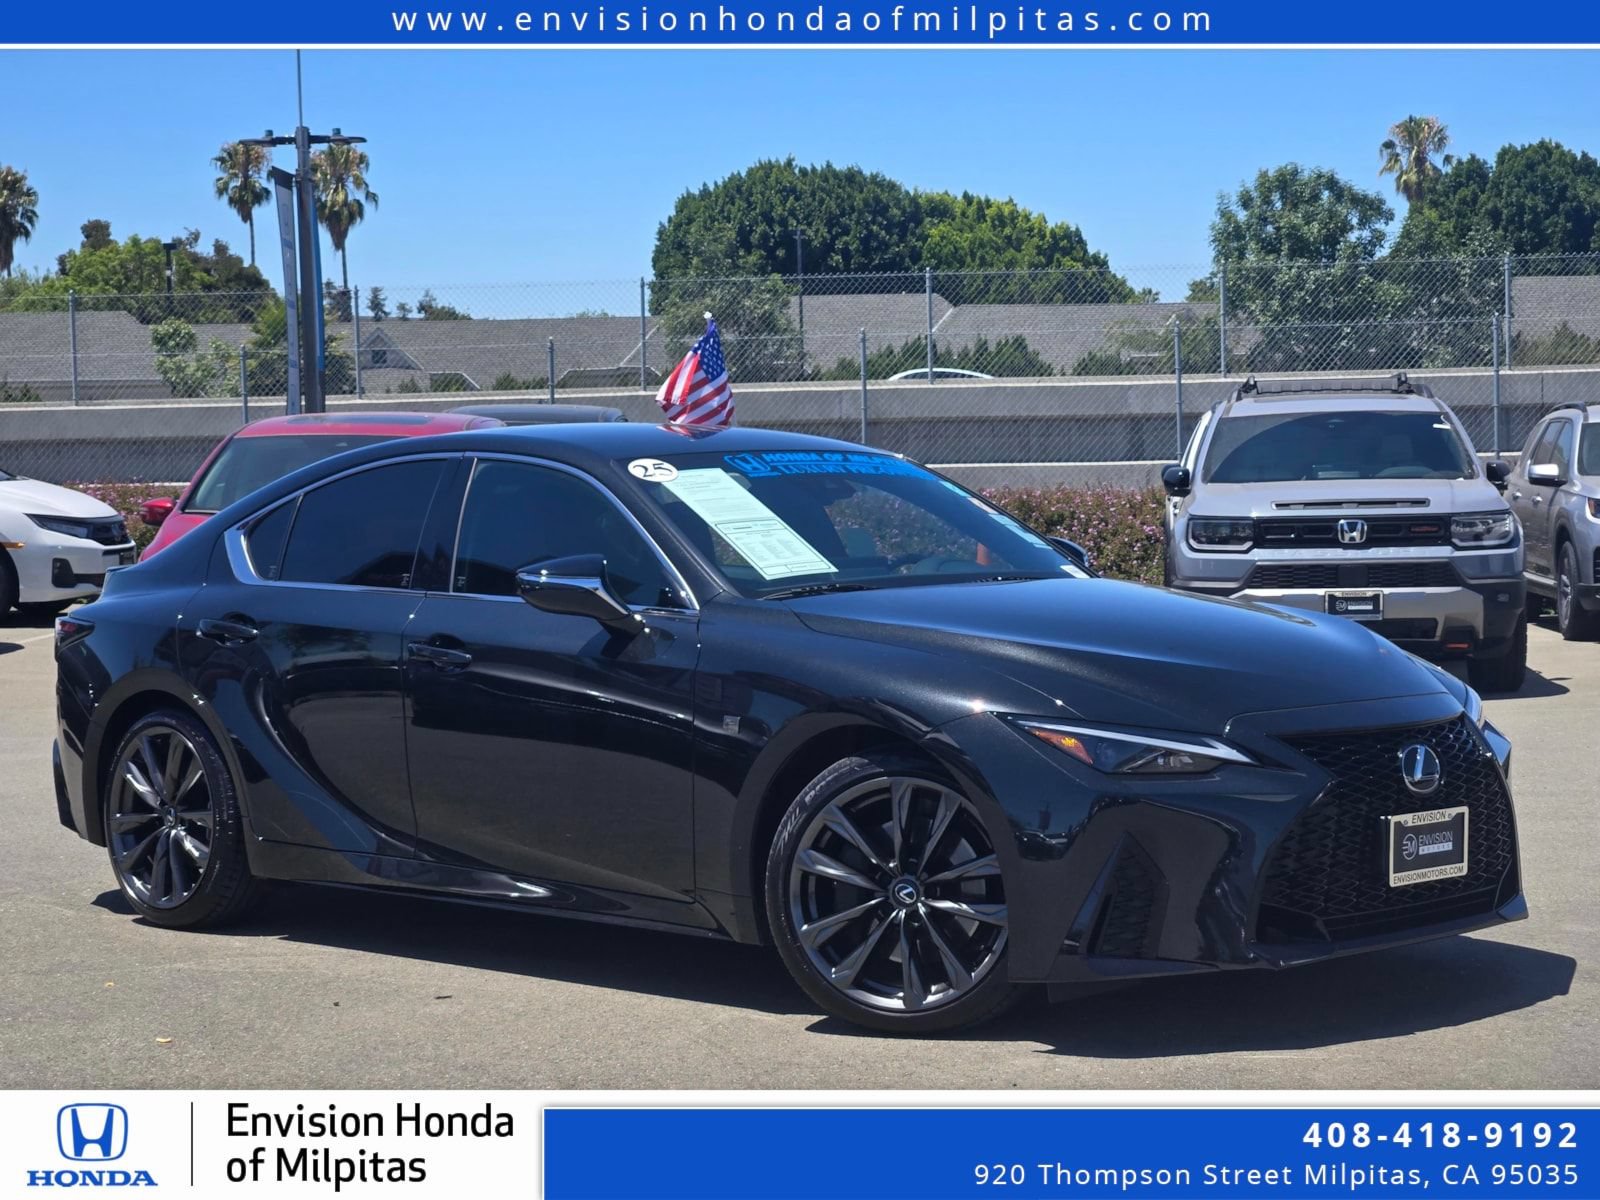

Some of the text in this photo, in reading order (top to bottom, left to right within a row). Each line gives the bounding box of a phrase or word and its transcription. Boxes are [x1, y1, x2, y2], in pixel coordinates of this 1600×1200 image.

[632, 463, 673, 477] 25
[1411, 810, 1447, 824] ENVISION
[1418, 831, 1453, 846] ENVISION
[1393, 865, 1464, 885] ENVISIONMOTORS.COM
